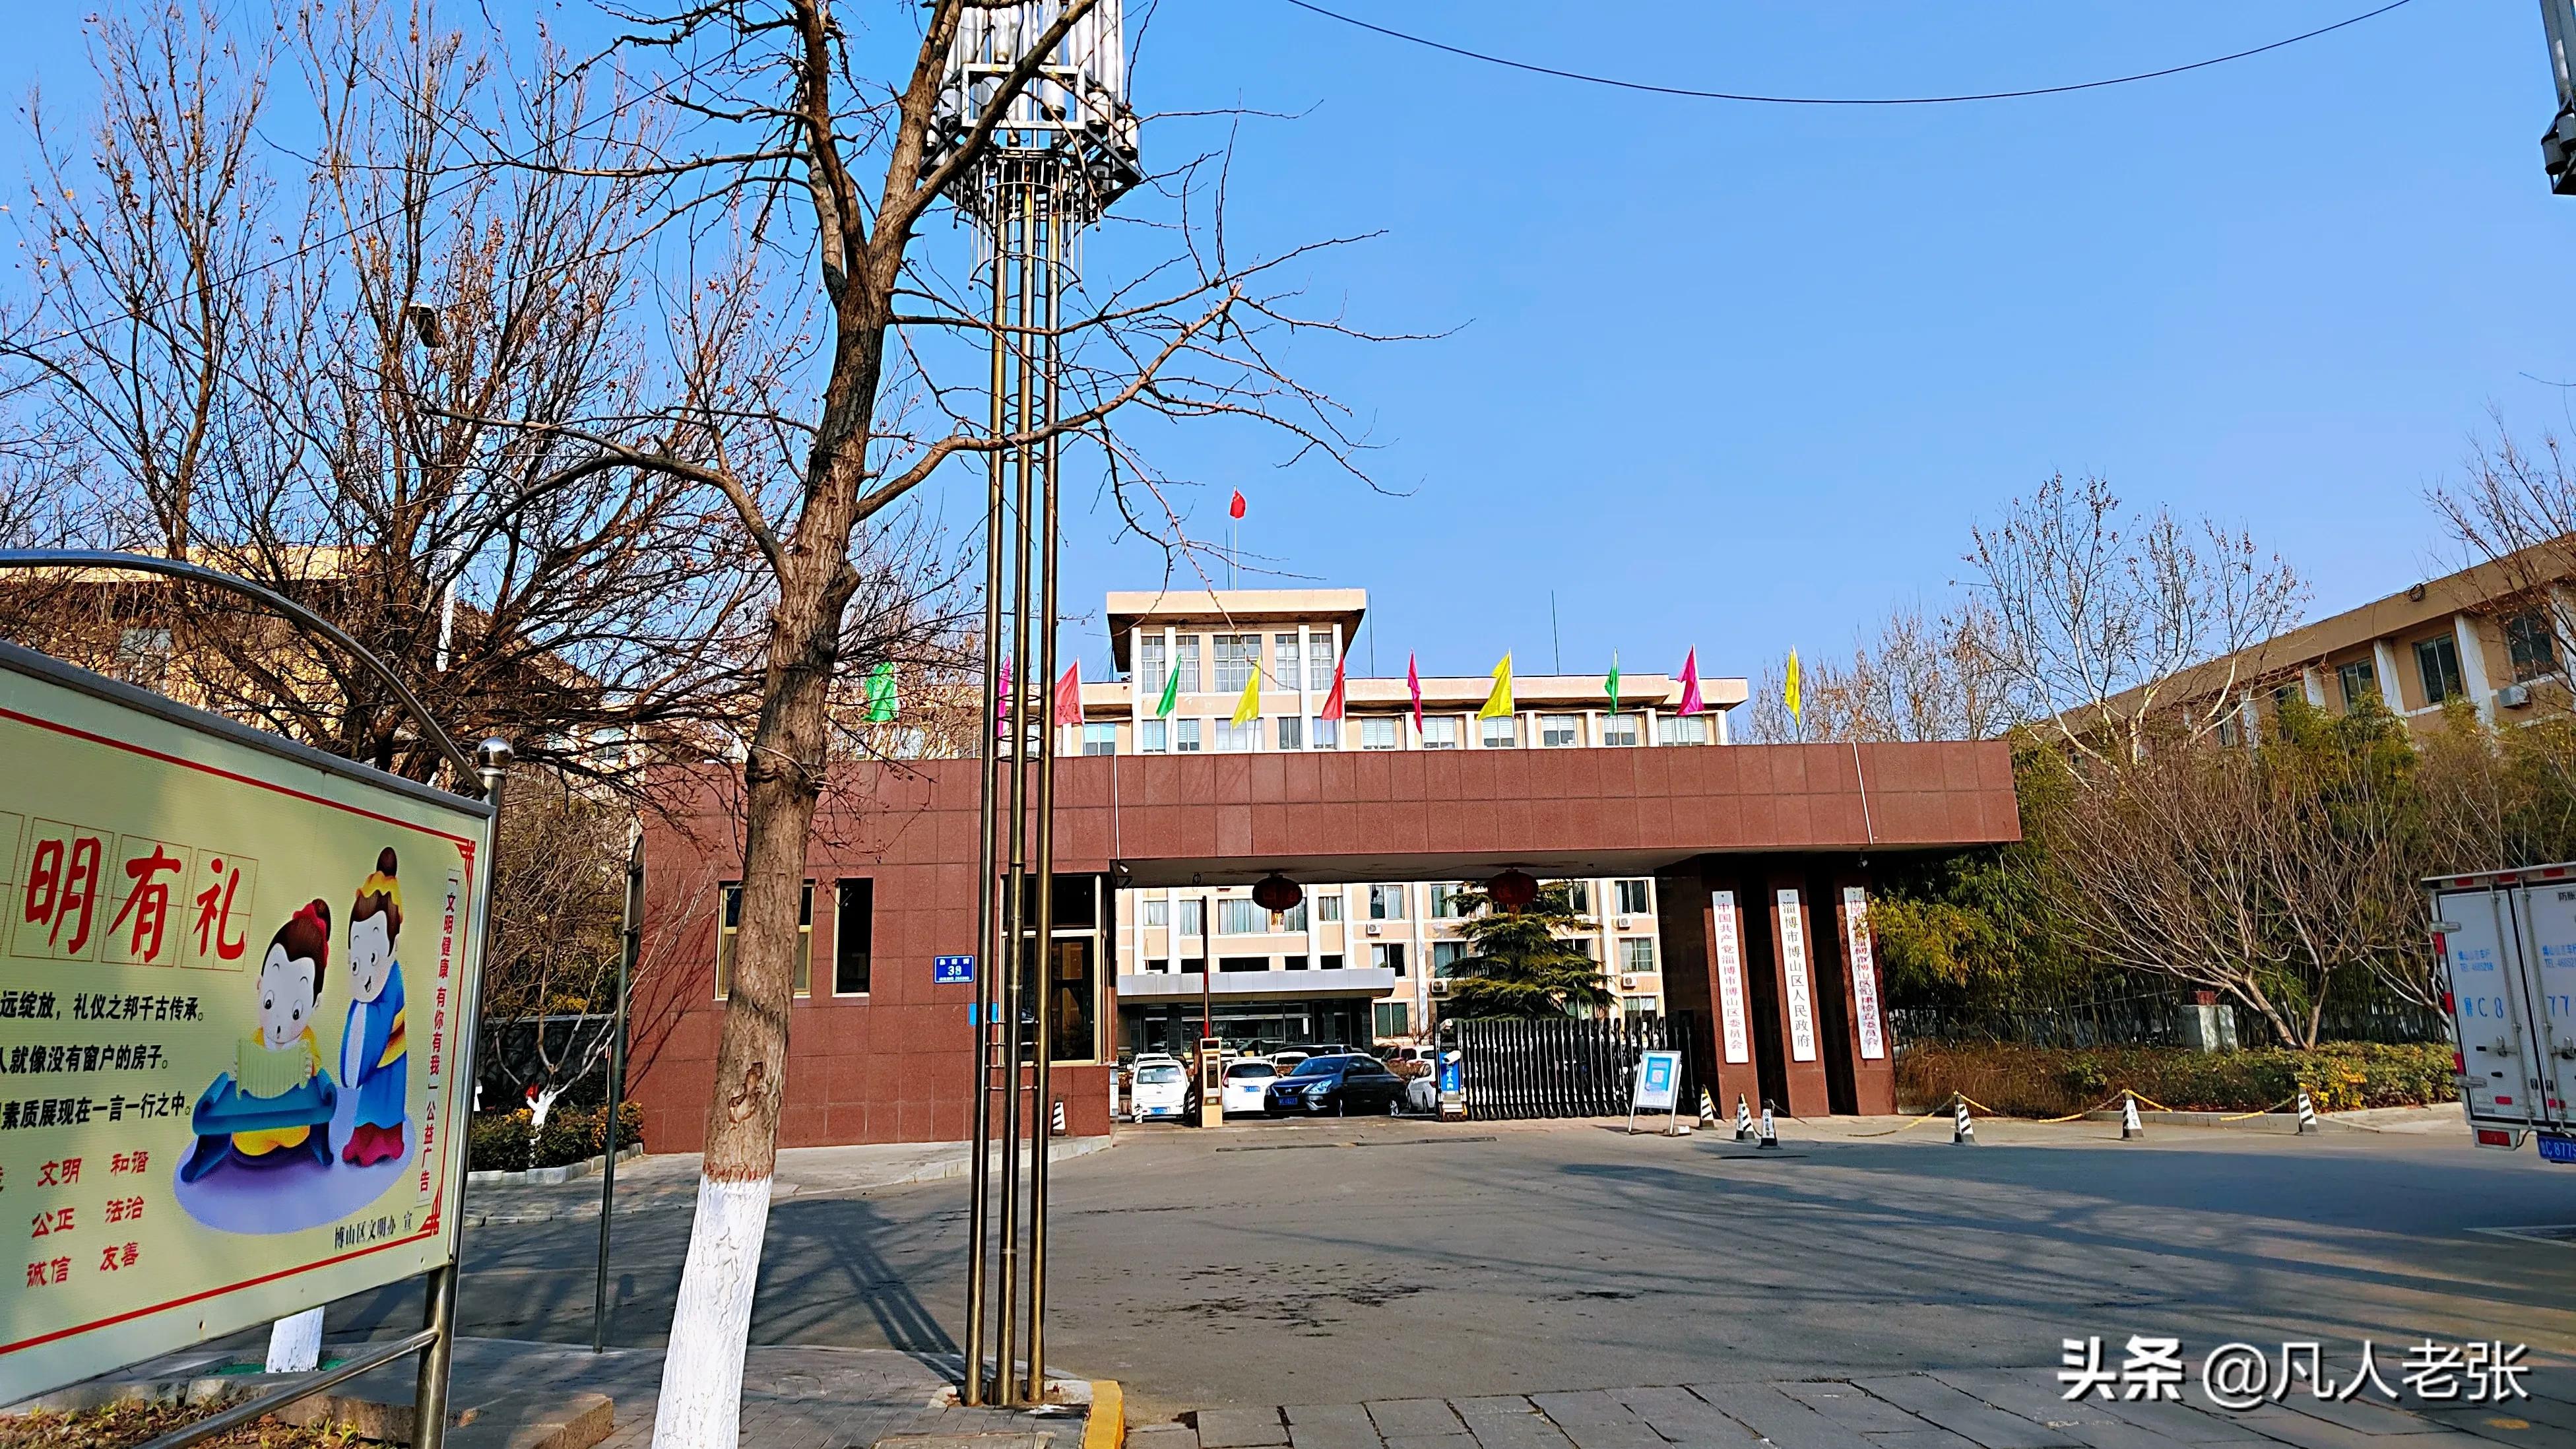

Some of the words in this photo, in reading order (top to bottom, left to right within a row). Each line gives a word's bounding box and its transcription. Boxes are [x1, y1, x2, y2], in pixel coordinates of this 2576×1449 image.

[25, 836, 245, 963] 明有礼
[948, 965, 962, 976] 38
[1718, 903, 1743, 1049] 中国共产党淄博市博山区委员会
[1783, 901, 1811, 1048] 淄博市博山区人民政府
[2547, 995, 2576, 1017] 77
[0, 1091, 191, 1130] 素质展现在一言一行之中。
[38, 1158, 82, 1187] 文明
[110, 1151, 149, 1176] 和谐
[31, 1208, 75, 1239] 公正
[105, 1196, 145, 1223] 法治
[335, 1215, 396, 1249] 博山区文明办
[27, 1256, 71, 1288] 诚信
[100, 1242, 139, 1272] 友善
